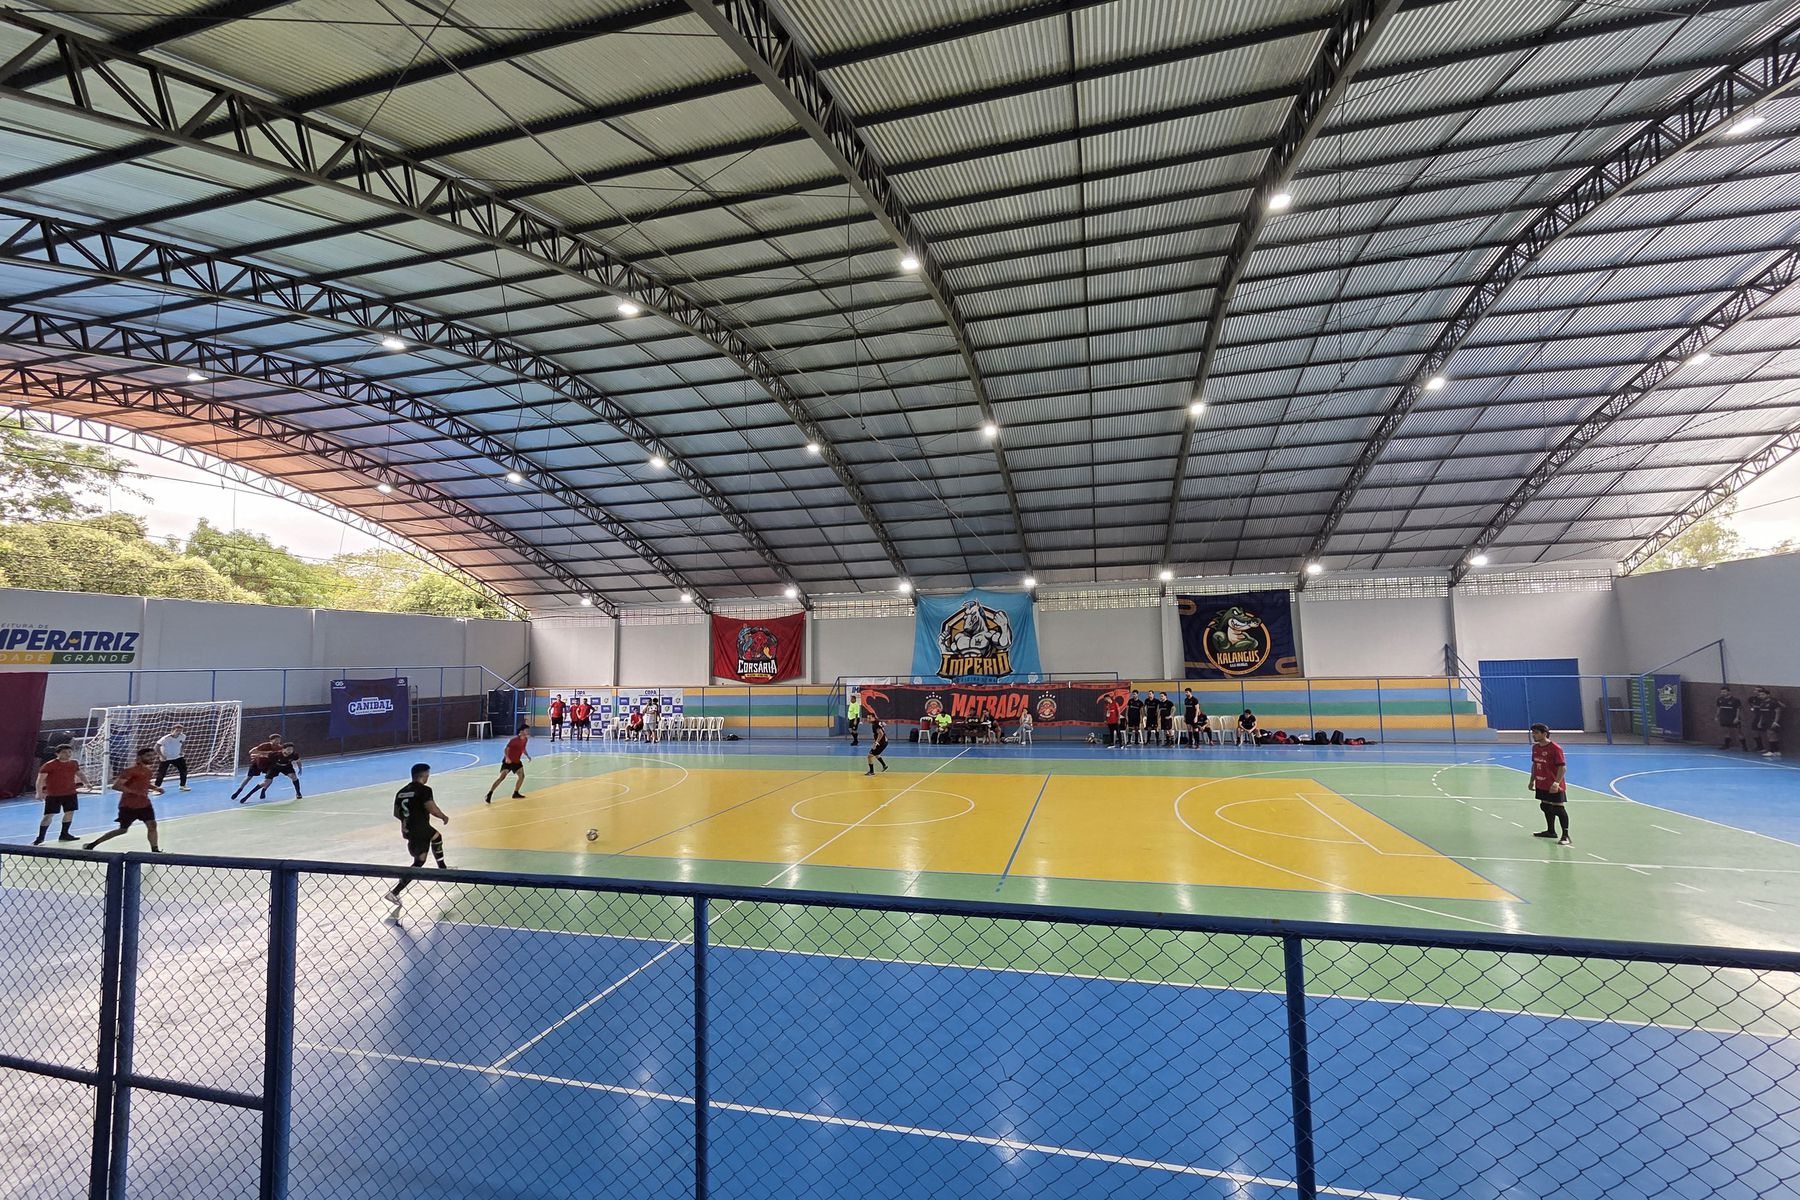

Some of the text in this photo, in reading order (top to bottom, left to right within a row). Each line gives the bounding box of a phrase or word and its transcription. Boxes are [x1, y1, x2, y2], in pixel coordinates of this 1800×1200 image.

[62, 654, 129, 662] GRANDE
[1216, 649, 1260, 665] KALANGUS
[349, 700, 393, 714] CANIBAL
[949, 692, 1029, 719] MATRACA
